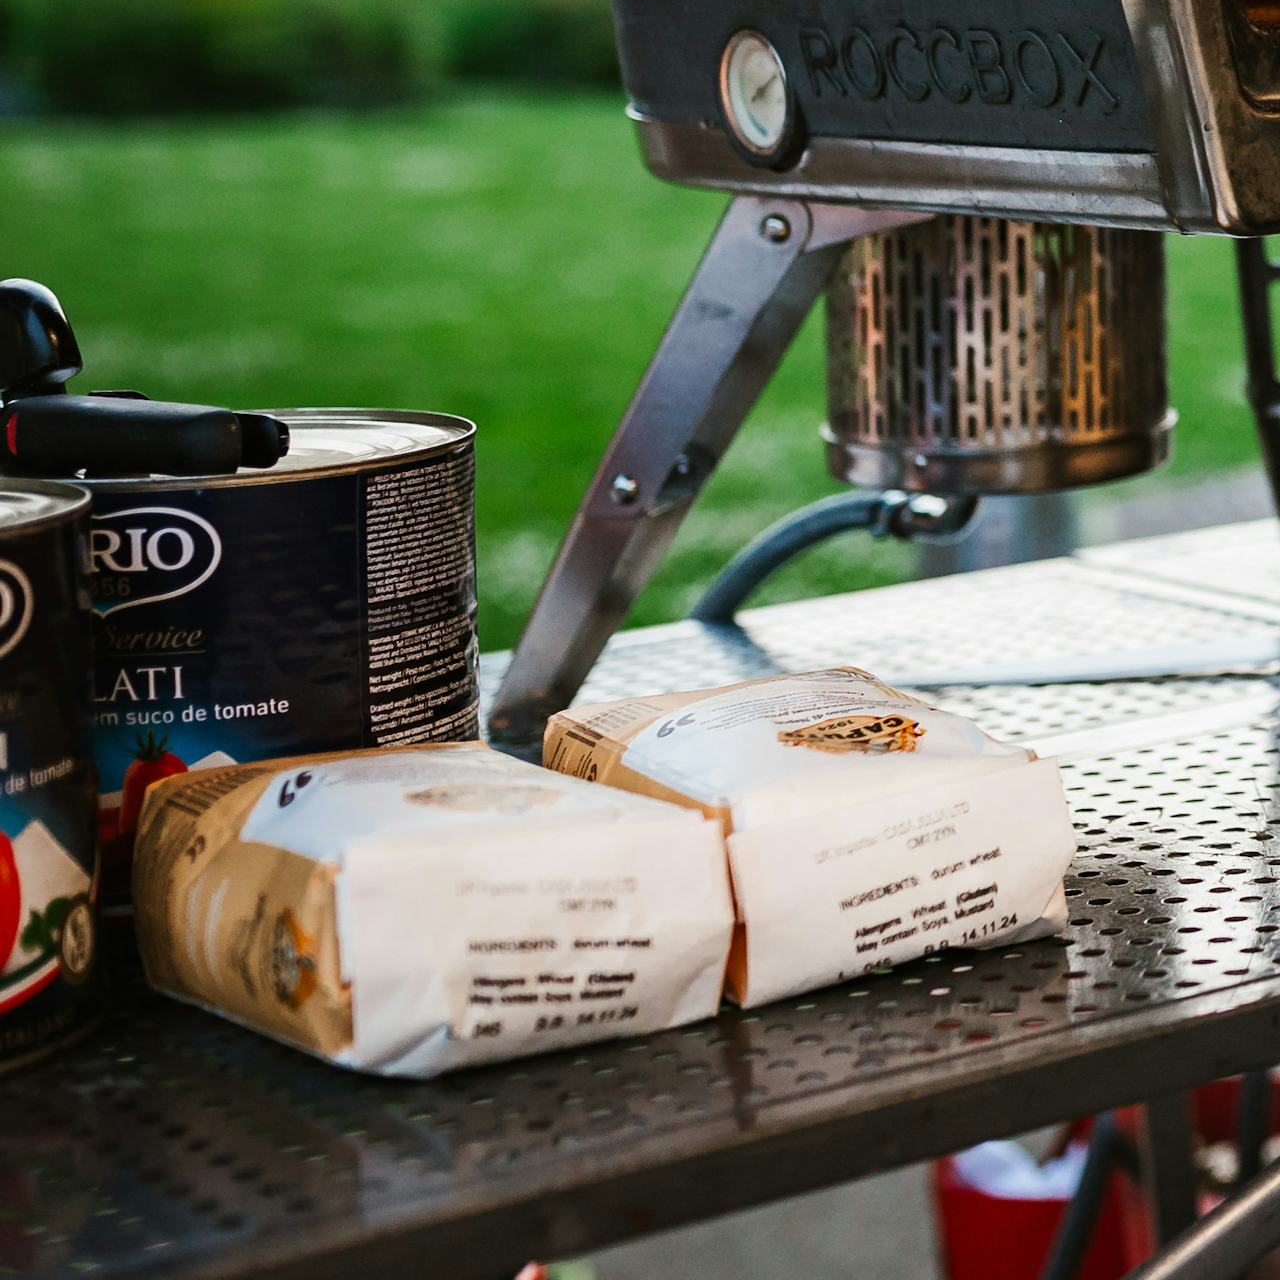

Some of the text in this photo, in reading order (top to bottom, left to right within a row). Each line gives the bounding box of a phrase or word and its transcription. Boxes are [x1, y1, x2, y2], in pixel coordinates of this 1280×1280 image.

[801, 26, 1121, 107] ROCCBOX
[86, 526, 195, 572] RIO
[95, 666, 185, 701] ATI
[126, 707, 174, 725] suco
[182, 704, 207, 722] de
[214, 698, 290, 720] tomate
[911, 900, 947, 920] Wheat
[962, 912, 1018, 945] 14.11.24
